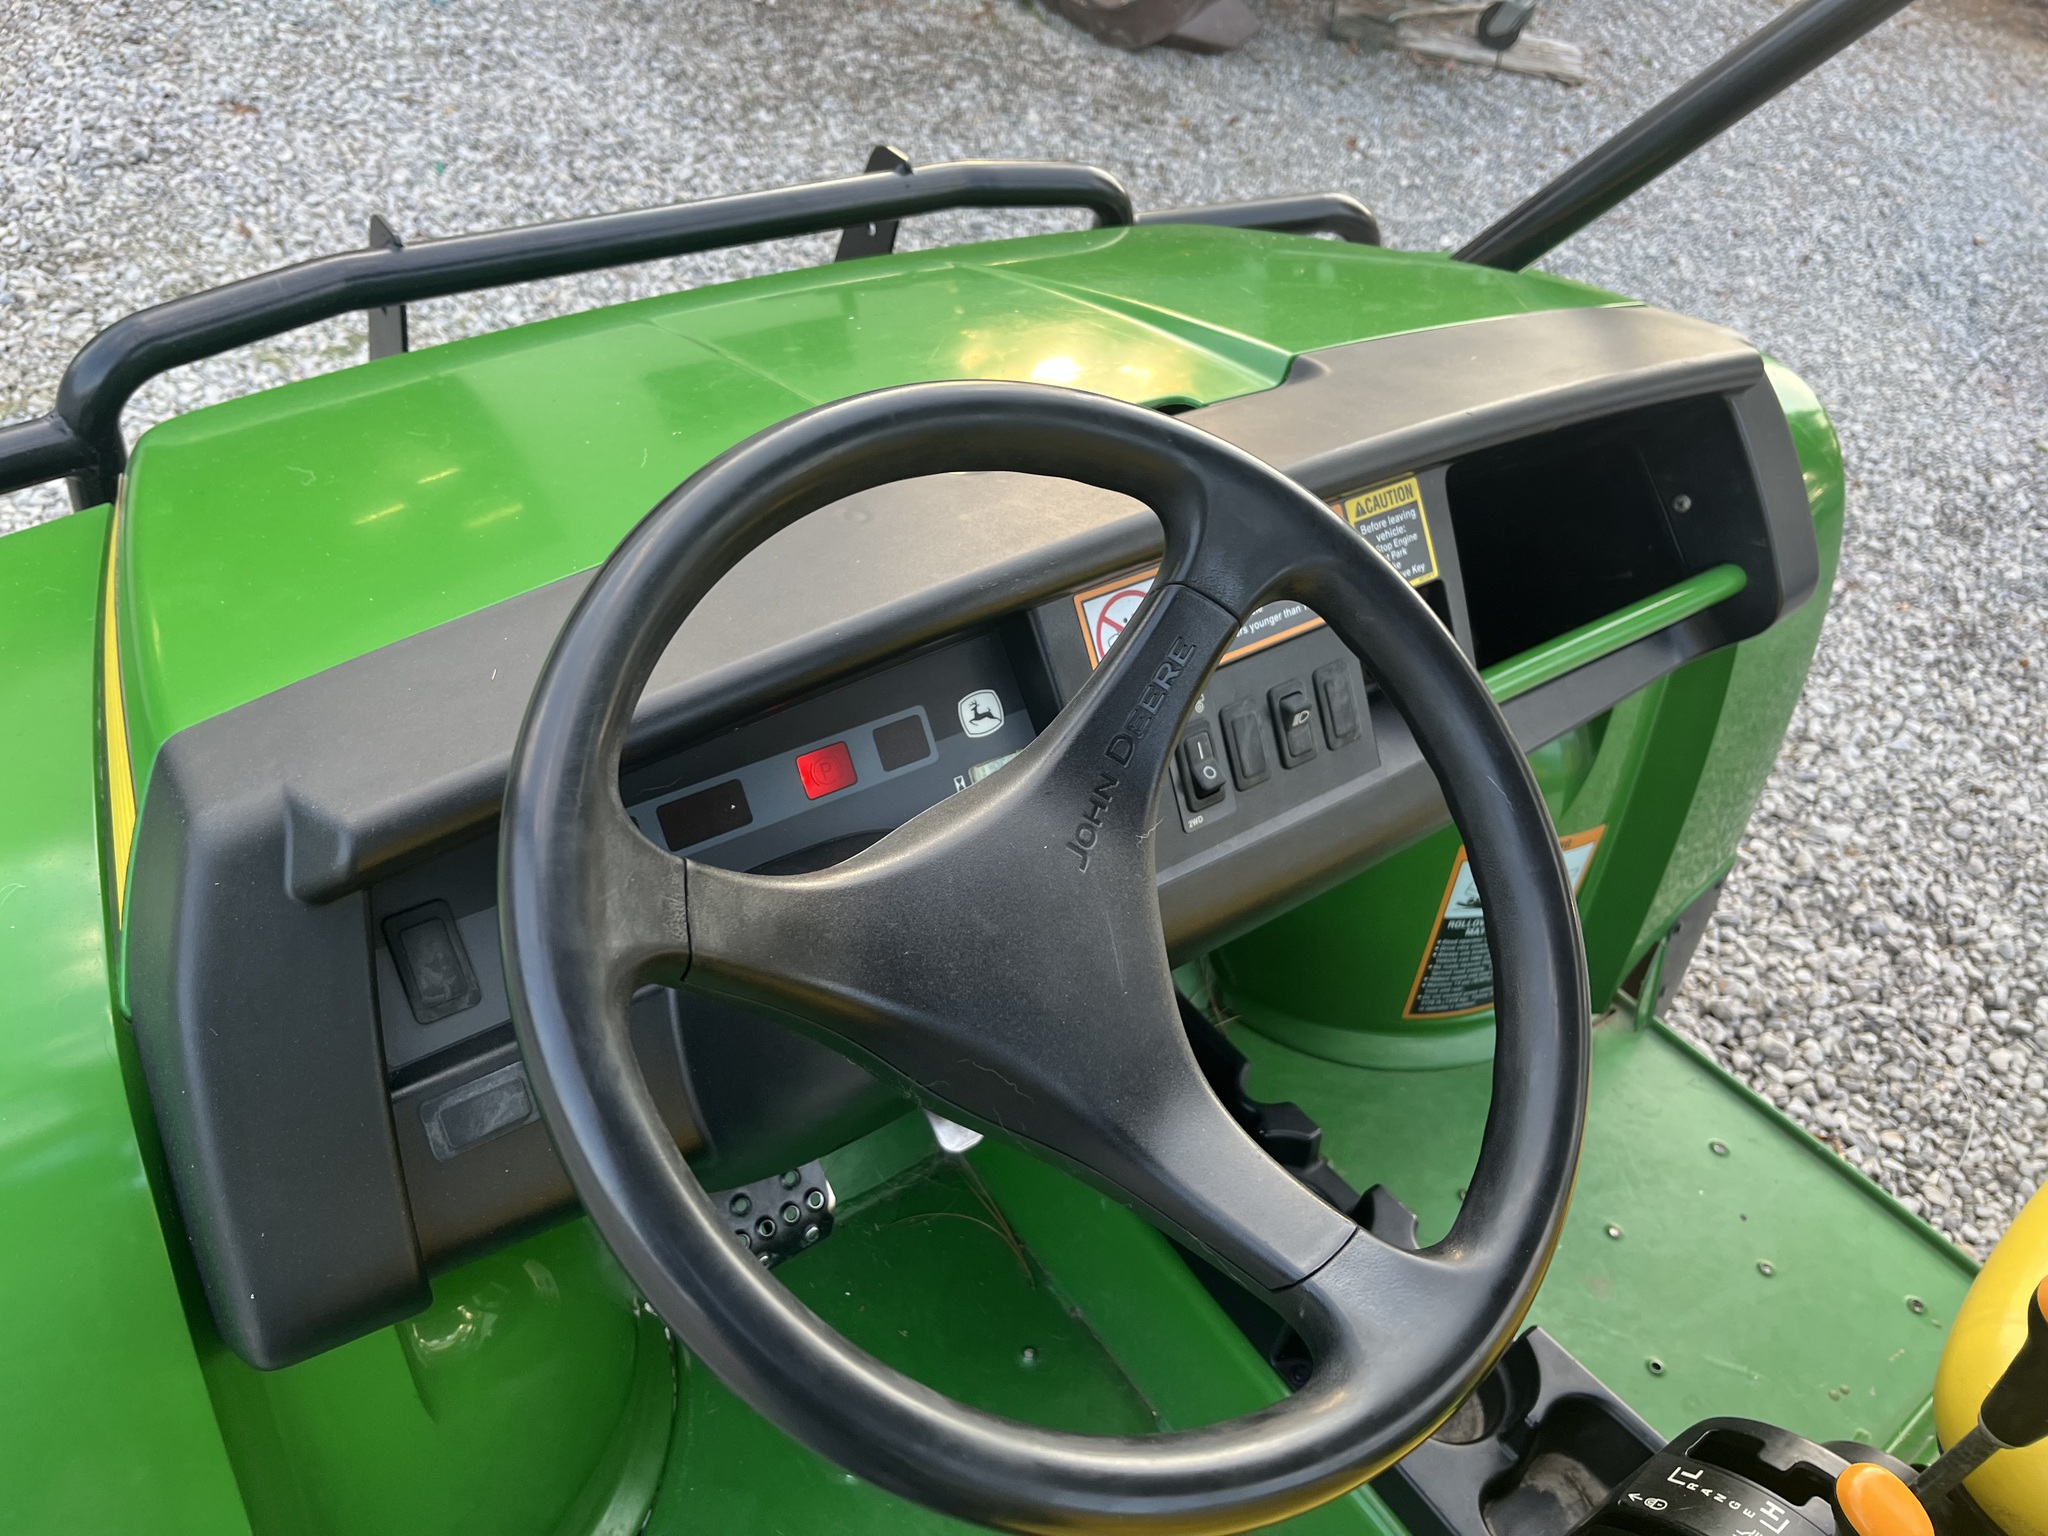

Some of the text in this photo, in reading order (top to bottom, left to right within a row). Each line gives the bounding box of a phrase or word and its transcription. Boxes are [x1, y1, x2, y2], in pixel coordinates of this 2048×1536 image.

[1365, 483, 1414, 513] CAUTION
[1360, 509, 1417, 536] Before leaving
[1375, 533, 1418, 553] Stop Engine
[1376, 525, 1407, 542] vehicle:
[1391, 548, 1408, 560] Park
[1411, 563, 1425, 574] Key
[1249, 612, 1282, 634] younger
[1283, 605, 1302, 618] than
[1066, 636, 1197, 873] JOHN DEERE
[1187, 815, 1204, 828] 2WD
[1680, 1469, 1704, 1480] L
[1686, 1482, 1756, 1519] RANGE
[1759, 1500, 1786, 1522] H
